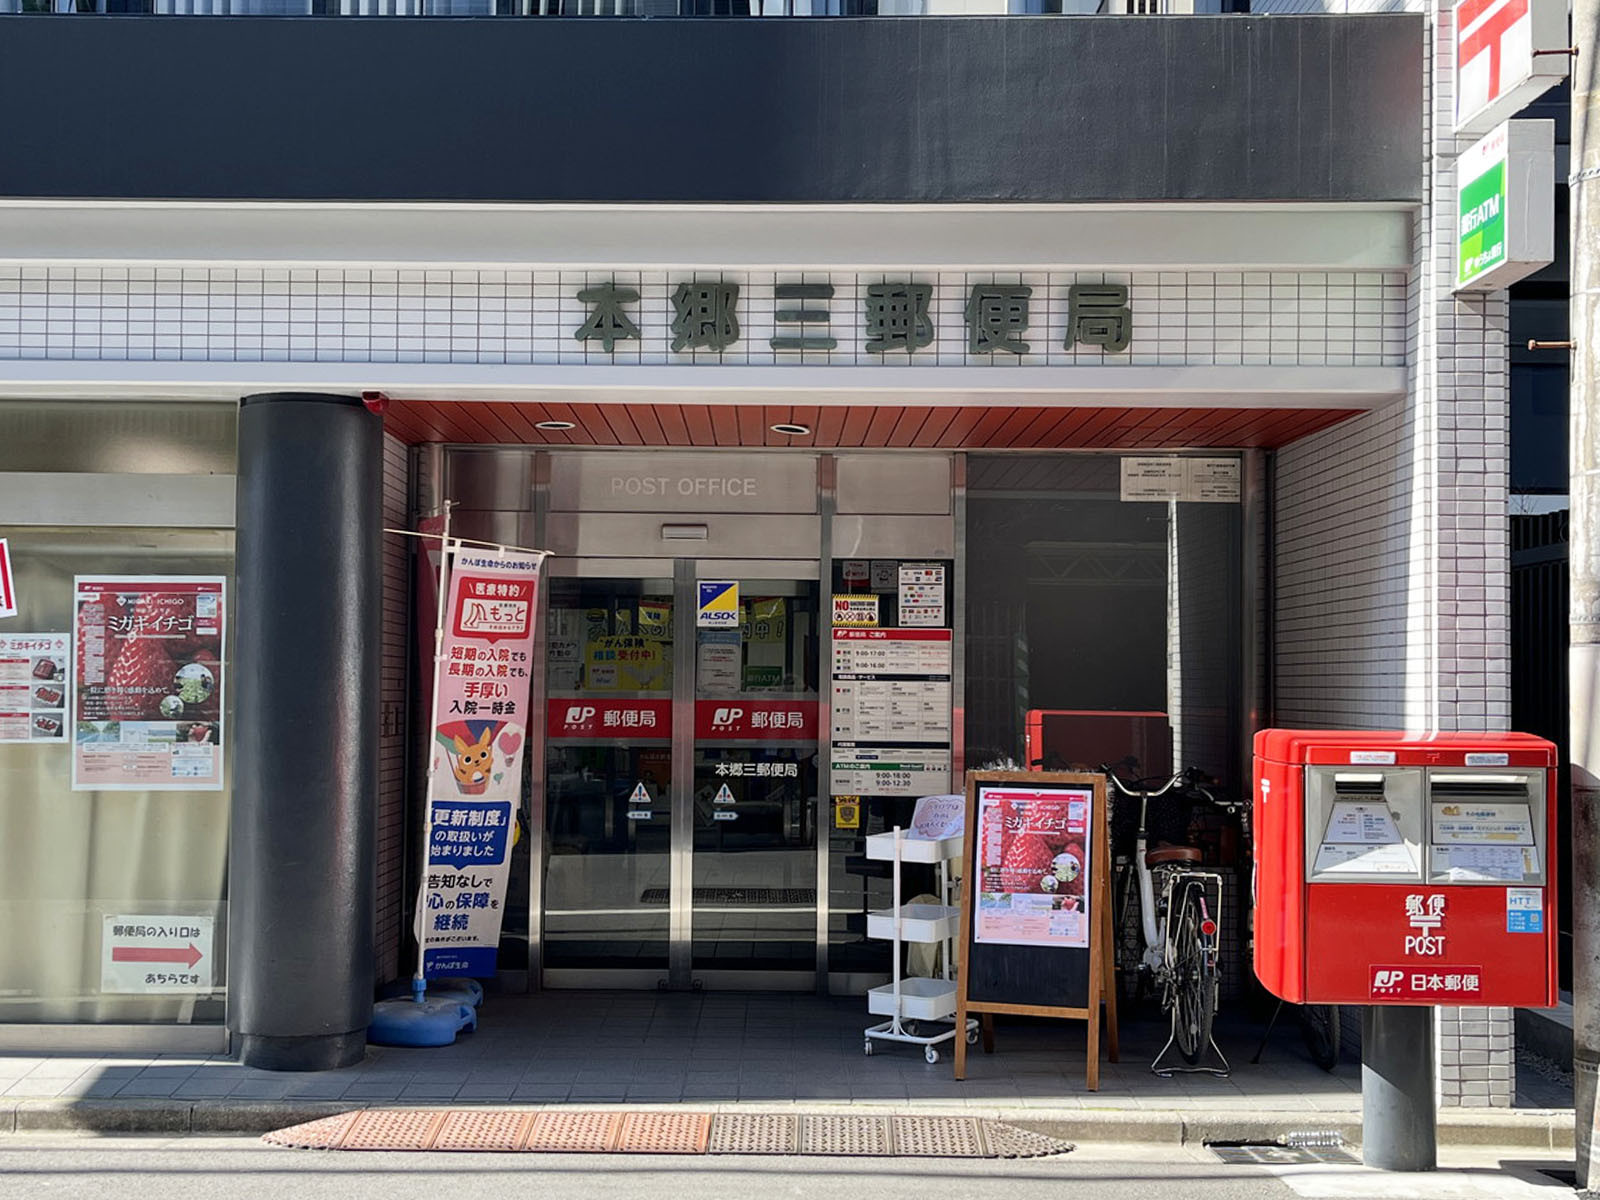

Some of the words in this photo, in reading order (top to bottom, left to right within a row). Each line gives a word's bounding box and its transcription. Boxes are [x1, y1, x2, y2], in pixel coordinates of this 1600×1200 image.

[574, 282, 1133, 354] 本郷三郵便局
[610, 477, 670, 496] POST
[678, 478, 758, 496] OFFICE
[475, 582, 520, 598] 医療特約
[835, 600, 849, 611] NO
[490, 606, 525, 622] もっと
[700, 611, 736, 620] ALSOK
[108, 616, 194, 632] ミガキイチゴ
[10, 641, 52, 650] ミガキイチゴ
[450, 646, 527, 662] 短期の入院でも
[448, 663, 528, 678] 長期の入院でも、
[464, 682, 508, 698] 手厚い
[450, 700, 516, 714] 入院一時金
[604, 710, 656, 728] 郵便局
[751, 712, 804, 728] 郵便局
[715, 762, 798, 778] 本郷三郵便局
[432, 808, 506, 826] 更新制度」
[1005, 816, 1068, 830] ミガキイチゴ
[434, 830, 495, 842] の取扱いが
[430, 844, 494, 858] 始まりました
[428, 874, 493, 888] 告知なしで
[426, 892, 498, 910] 心の保障を
[1405, 894, 1446, 917] 郵便
[434, 914, 470, 931] 継続
[113, 925, 200, 938] 郵便局の入り口は
[1405, 936, 1446, 956] POST
[145, 974, 200, 984] あちらです
[1411, 974, 1480, 992] 日本郵便
